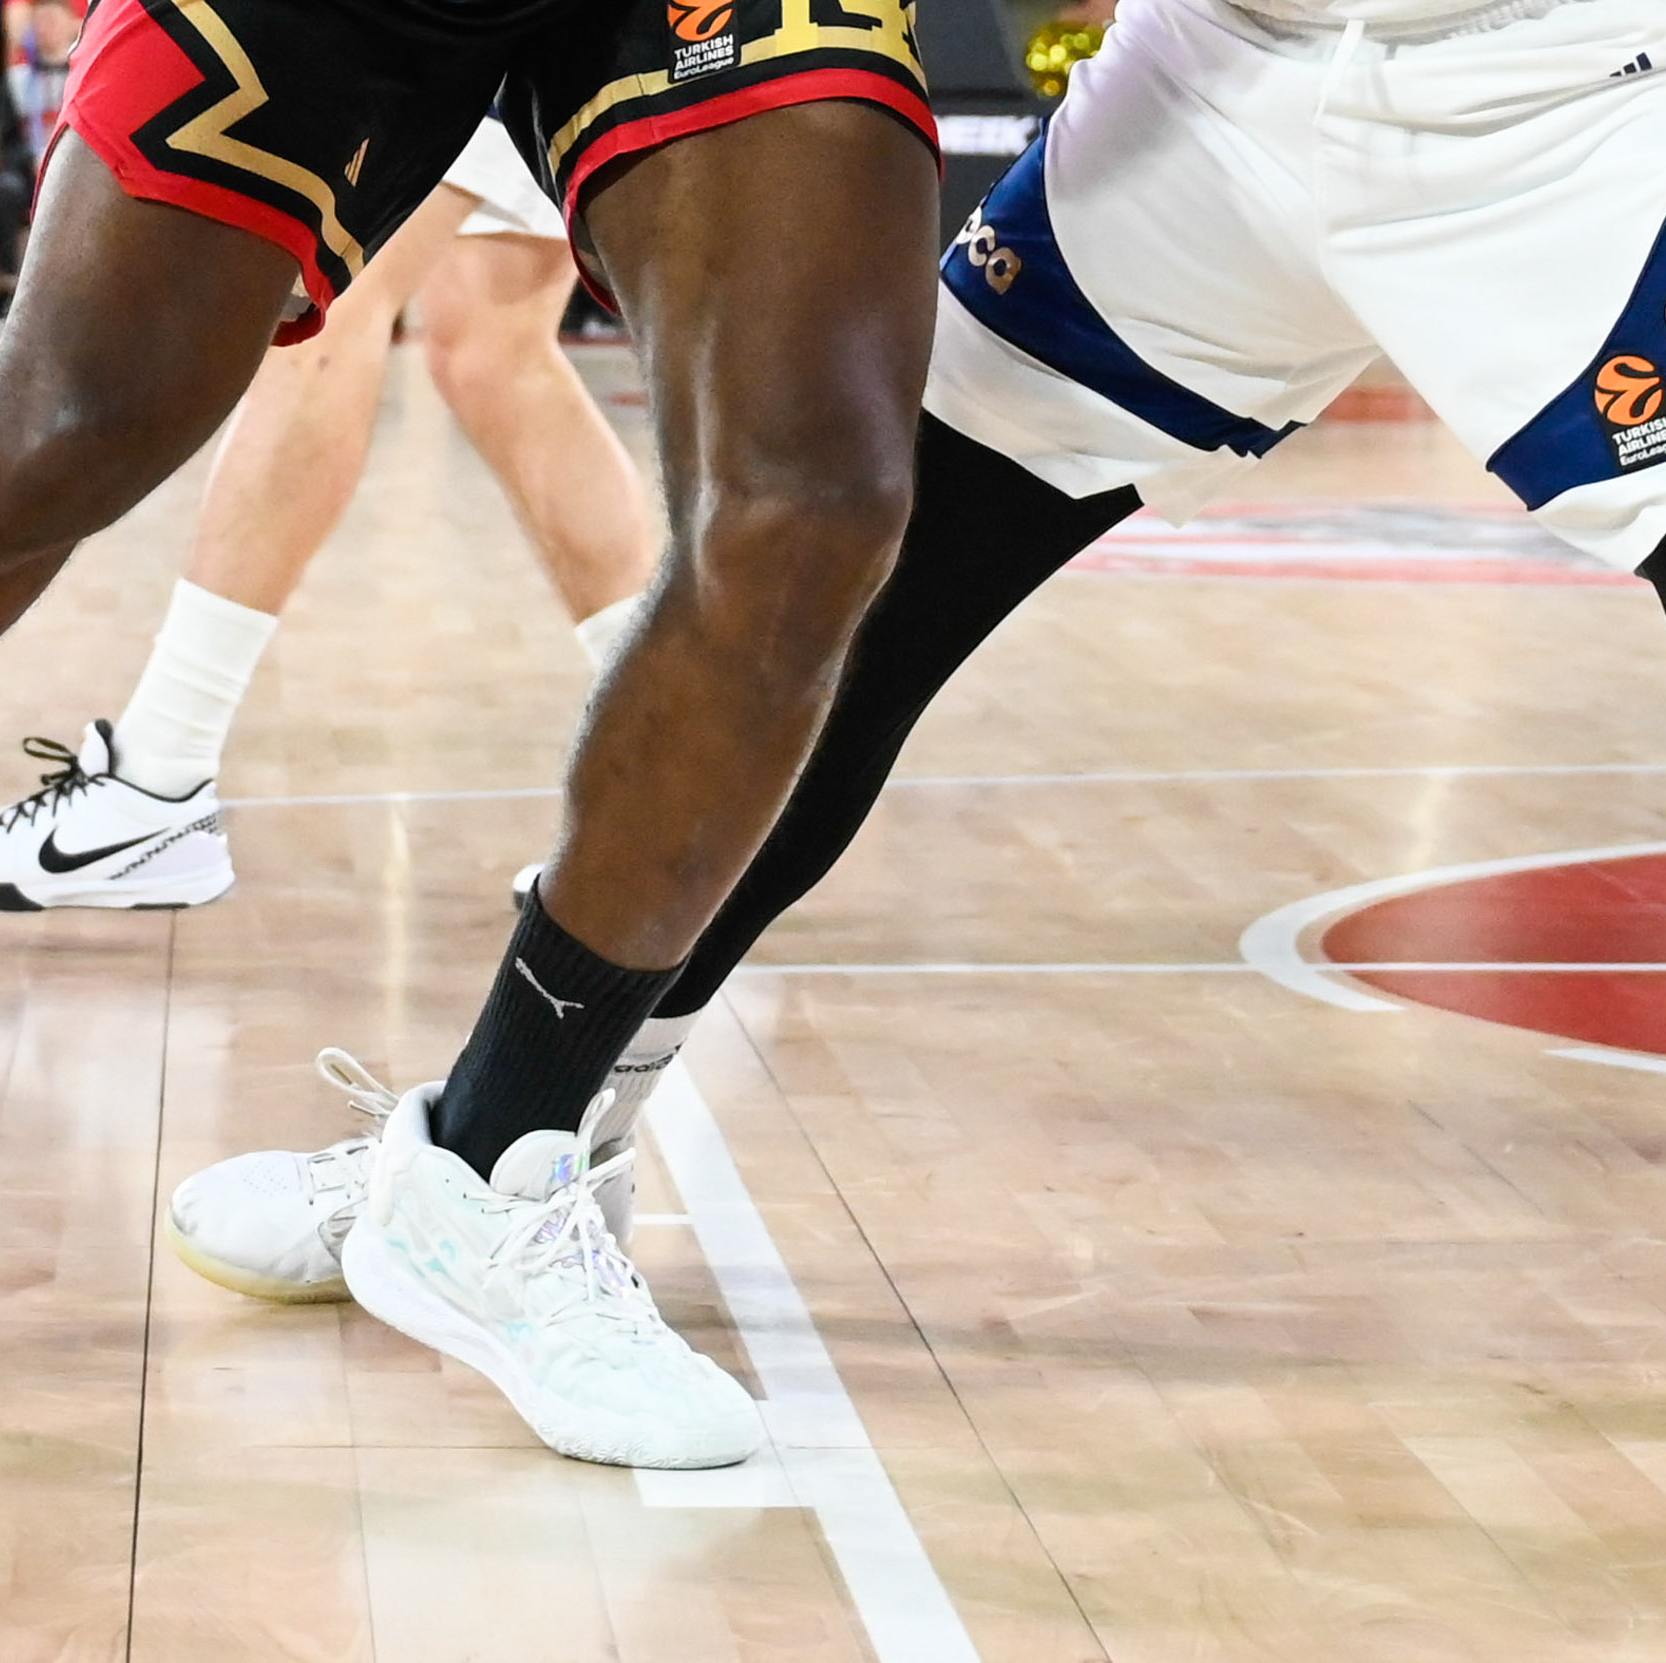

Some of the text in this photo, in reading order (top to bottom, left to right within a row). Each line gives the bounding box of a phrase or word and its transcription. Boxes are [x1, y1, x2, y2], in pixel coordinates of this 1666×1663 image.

[674, 34, 734, 61] TURKISH
[675, 45, 735, 72] AIRLINES
[673, 56, 735, 81] EuroLeague
